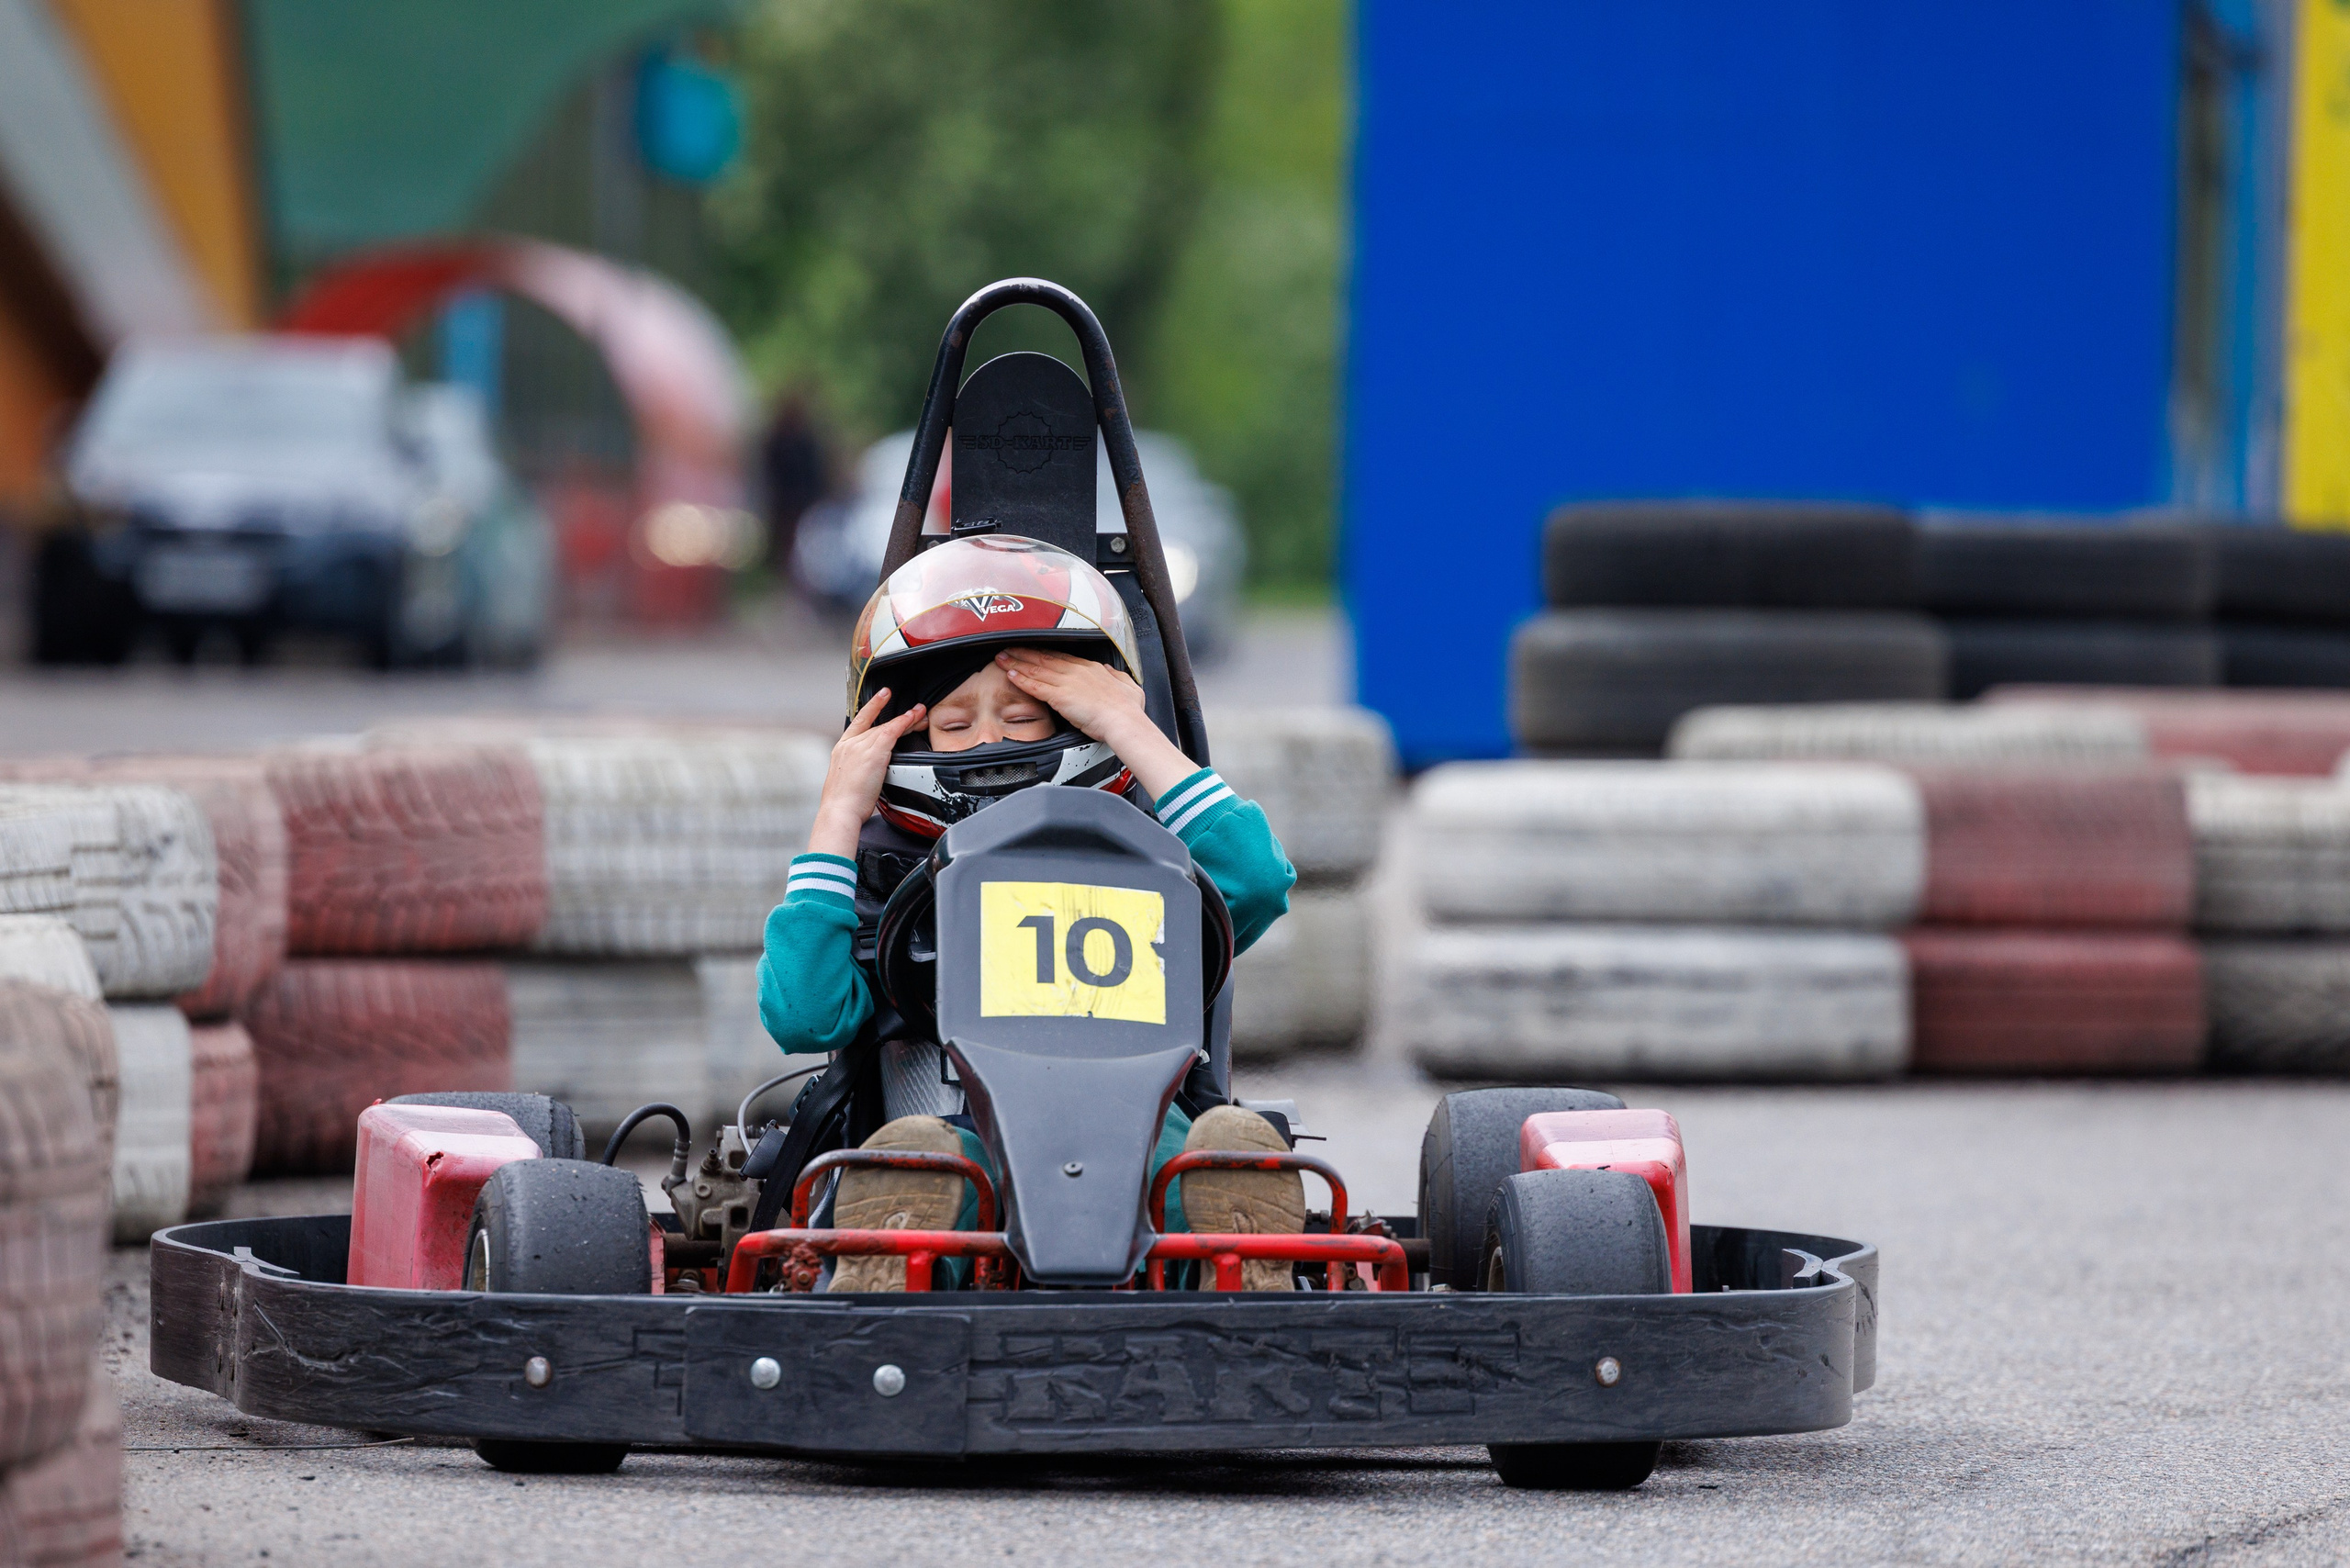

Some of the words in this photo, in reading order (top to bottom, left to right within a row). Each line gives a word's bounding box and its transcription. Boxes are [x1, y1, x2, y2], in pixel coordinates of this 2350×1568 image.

[977, 435, 1072, 451] SD-KART
[980, 604, 1016, 615] VEGA
[1016, 915, 1134, 987] 10
